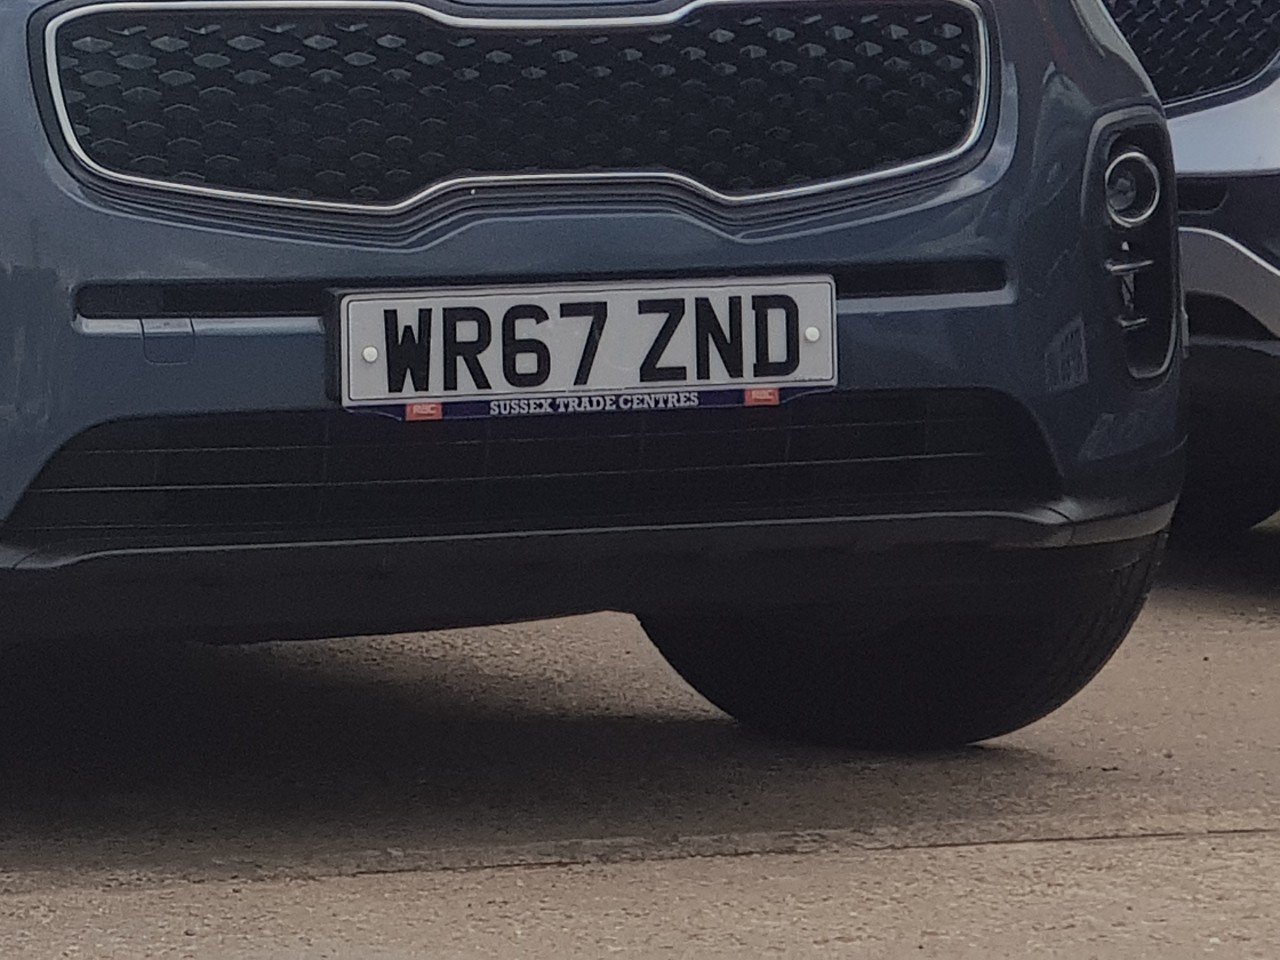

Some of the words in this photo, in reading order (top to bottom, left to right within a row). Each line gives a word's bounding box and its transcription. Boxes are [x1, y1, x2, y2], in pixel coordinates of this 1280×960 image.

[383, 301, 608, 394] WR67
[637, 293, 800, 384] ZND
[489, 397, 553, 416] SUSSEX
[555, 394, 616, 413] TRADE
[619, 391, 699, 410] CENTRES
